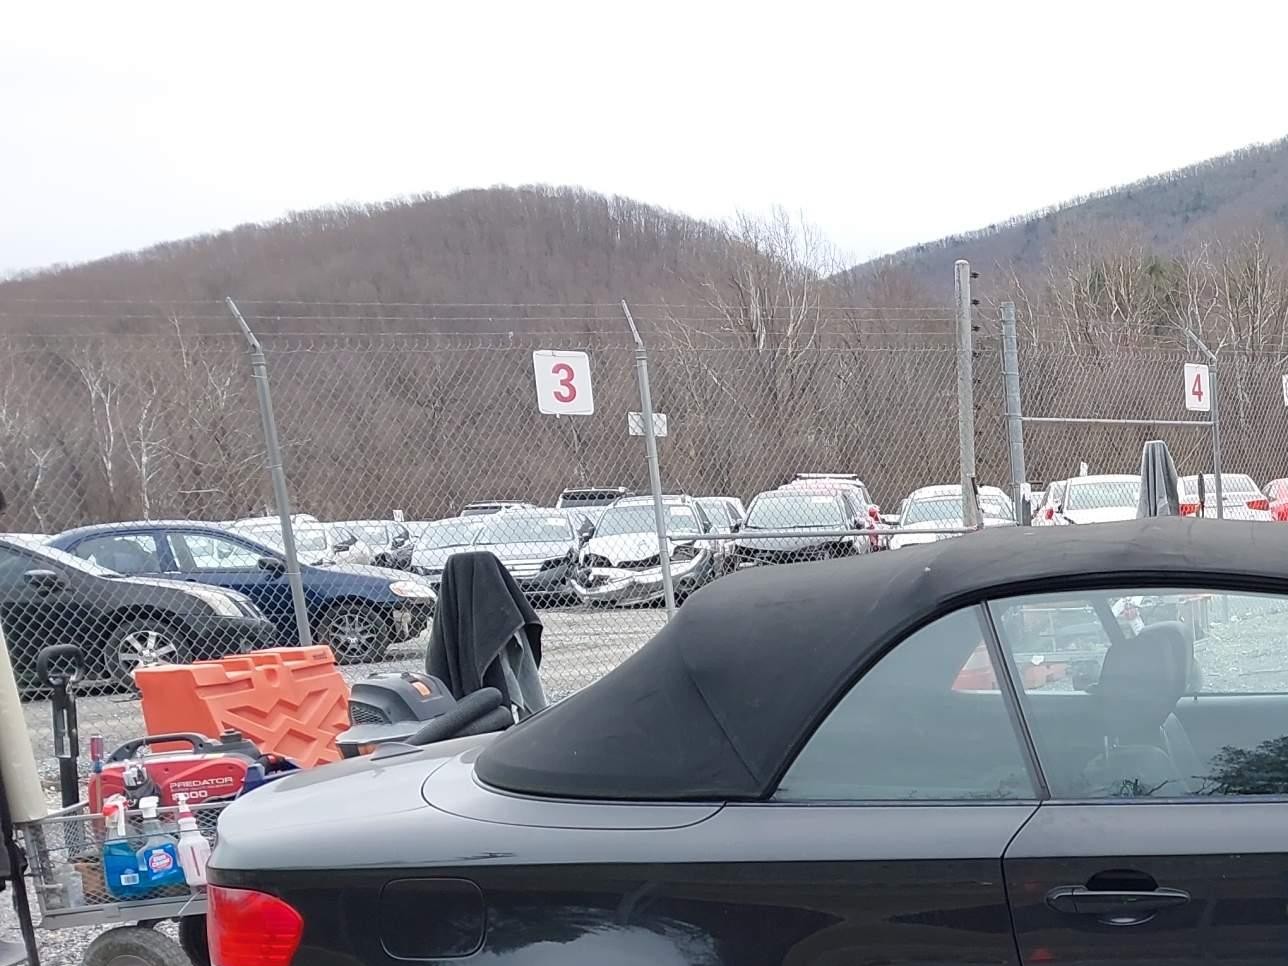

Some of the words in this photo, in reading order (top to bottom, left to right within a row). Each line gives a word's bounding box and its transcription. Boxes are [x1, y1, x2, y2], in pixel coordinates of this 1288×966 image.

[551, 362, 577, 403] 3
[1191, 373, 1204, 402] 4
[169, 776, 233, 789] PREDATOR
